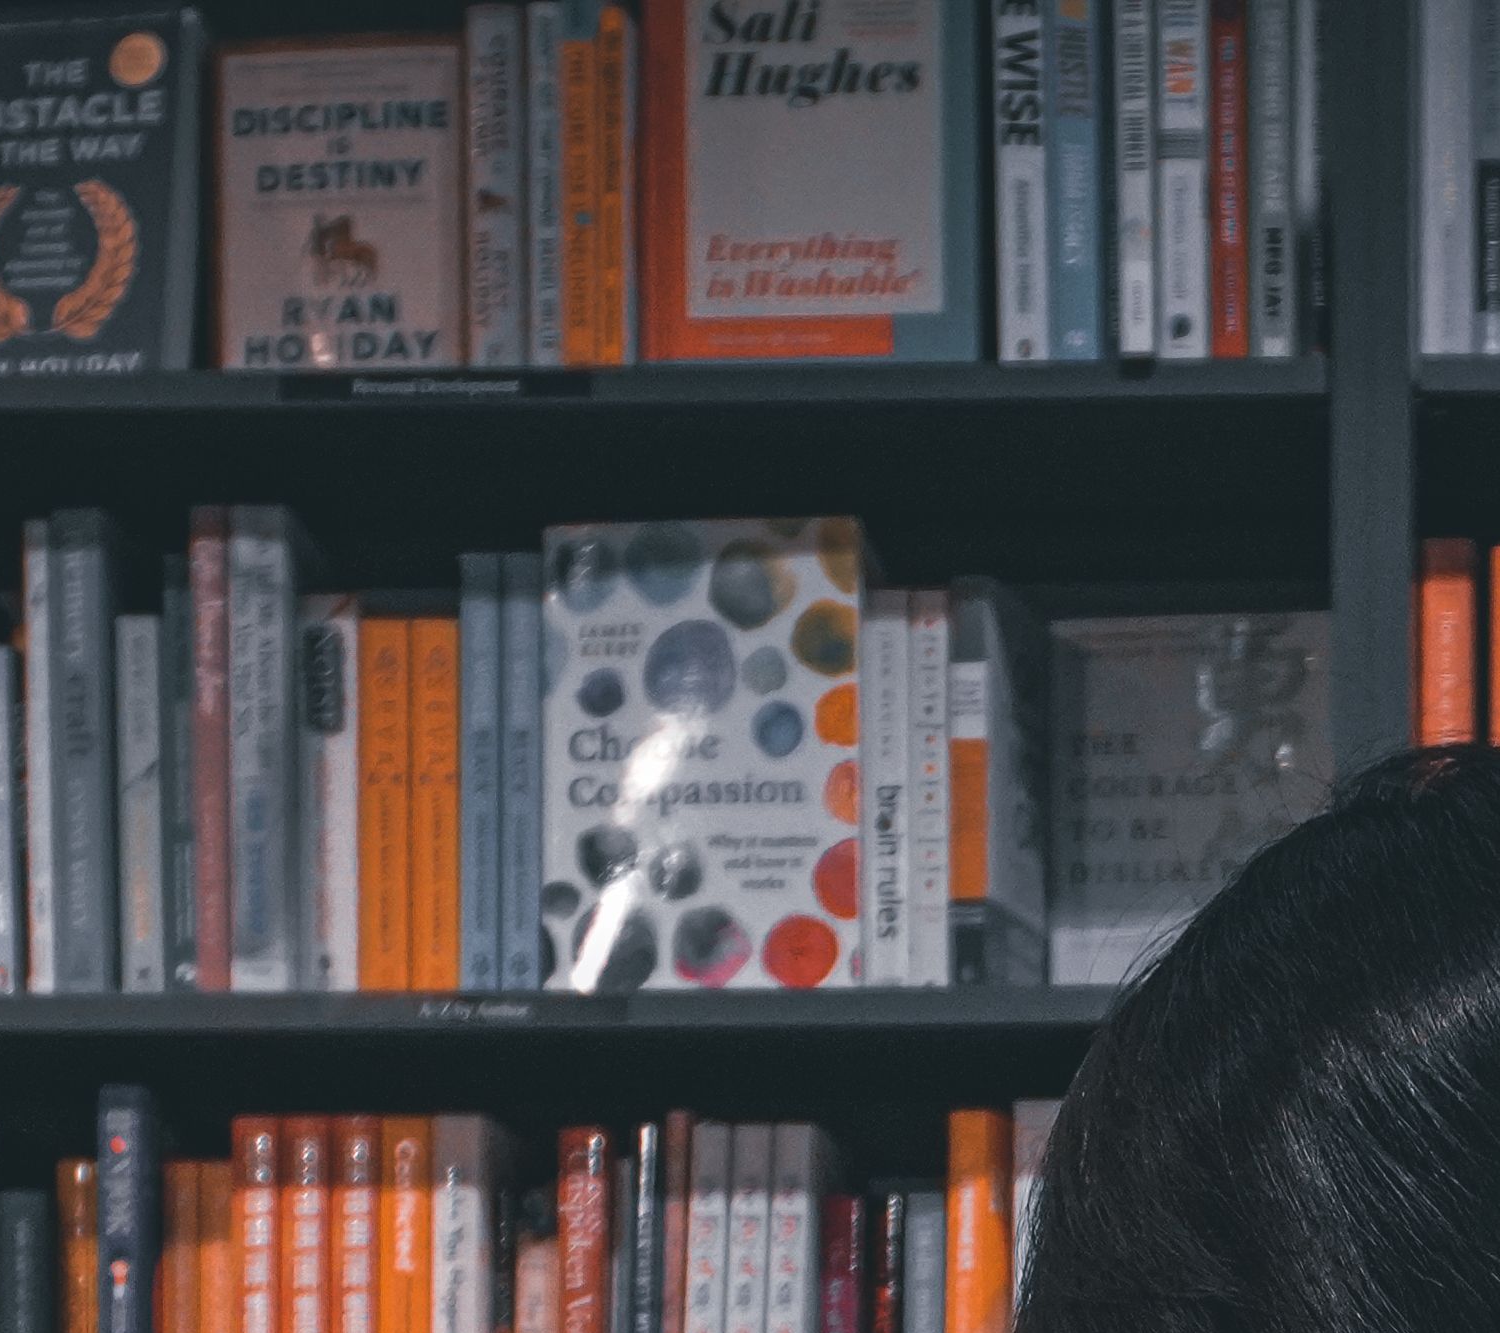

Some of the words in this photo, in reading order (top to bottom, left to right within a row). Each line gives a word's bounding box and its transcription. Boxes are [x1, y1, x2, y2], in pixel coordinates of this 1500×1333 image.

[24, 62, 87, 86] THE
[706, 49, 921, 107] Hughes
[1002, 29, 1041, 146] WISE
[234, 104, 448, 137] DISCIPLINE
[71, 135, 143, 160] WAY
[256, 163, 423, 193] DESTINY
[706, 234, 897, 268] Everything
[1068, 770, 1239, 799] COURAGE
[1129, 816, 1168, 840] BE
